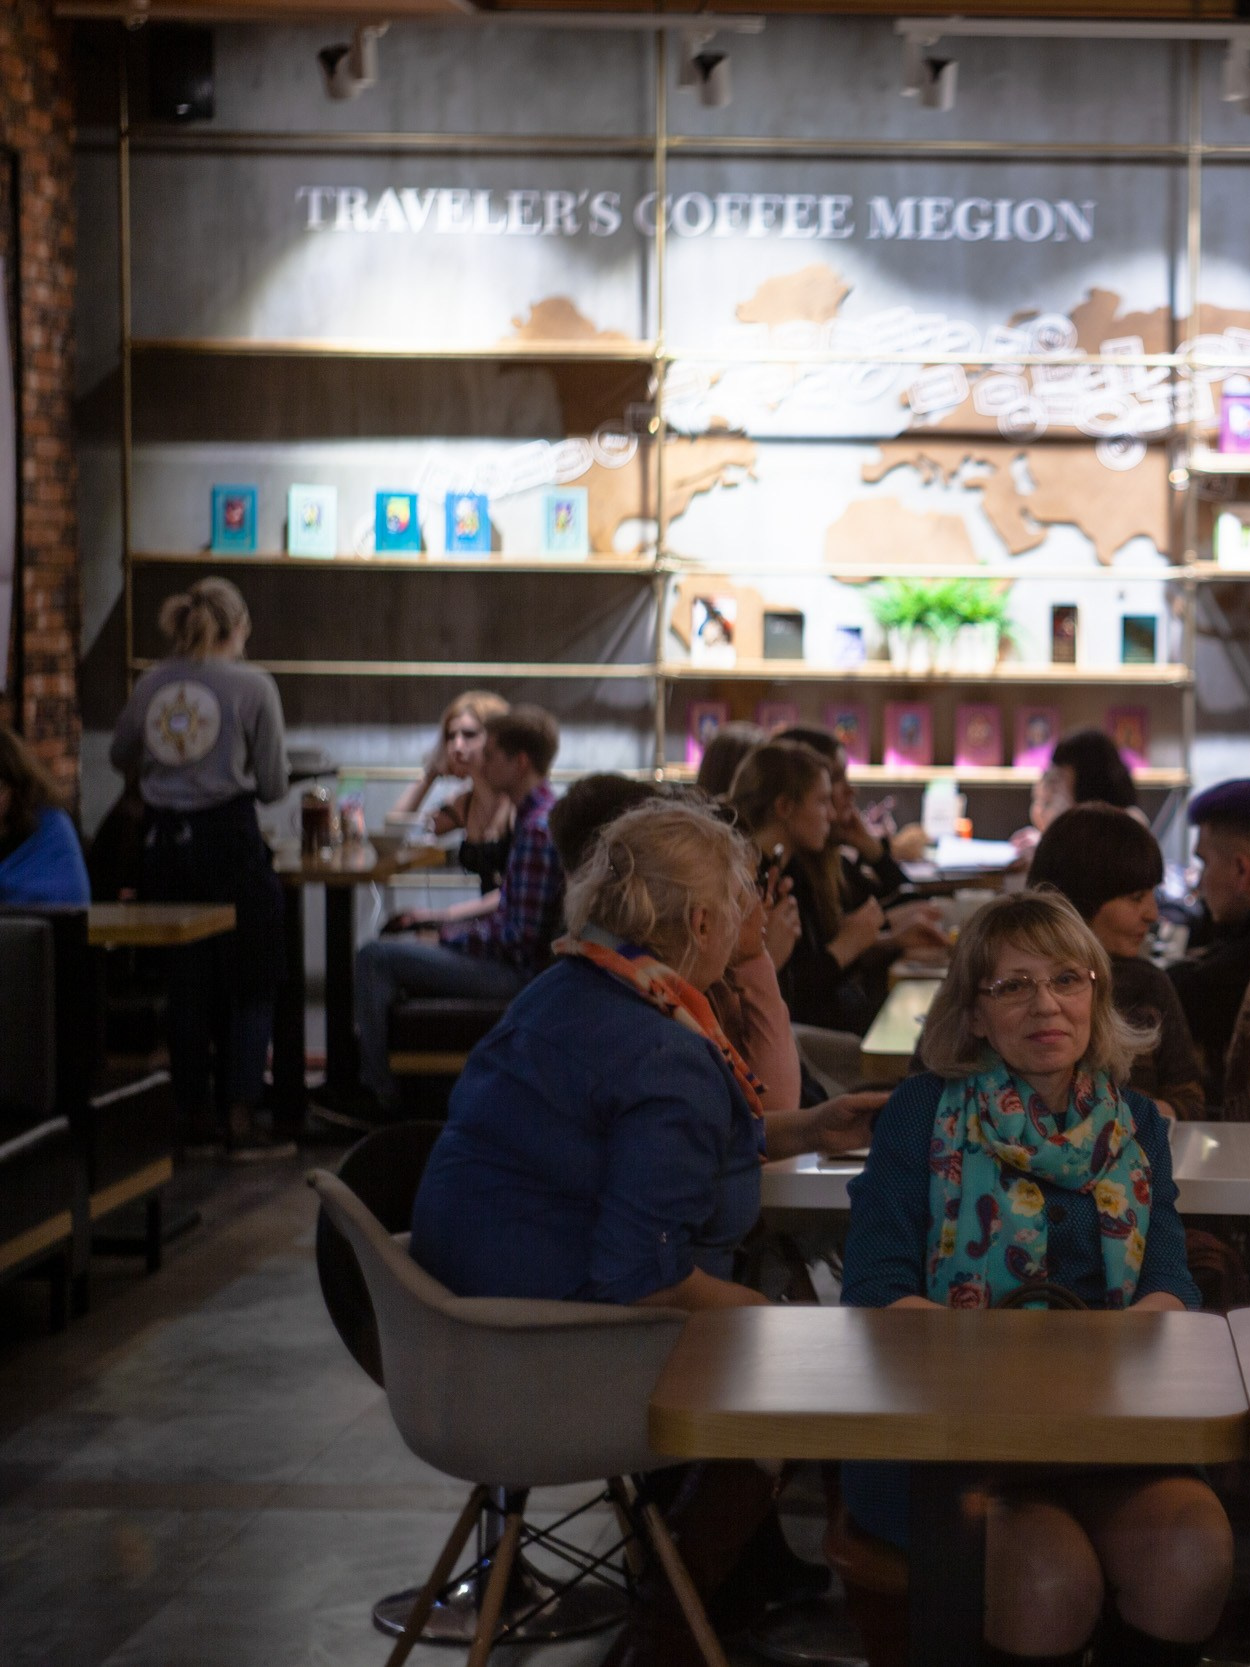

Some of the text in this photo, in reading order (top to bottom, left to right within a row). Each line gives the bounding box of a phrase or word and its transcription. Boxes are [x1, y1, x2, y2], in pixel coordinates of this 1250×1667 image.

[294, 185, 1097, 243] TRAVELER'S COFFEE MEGION
